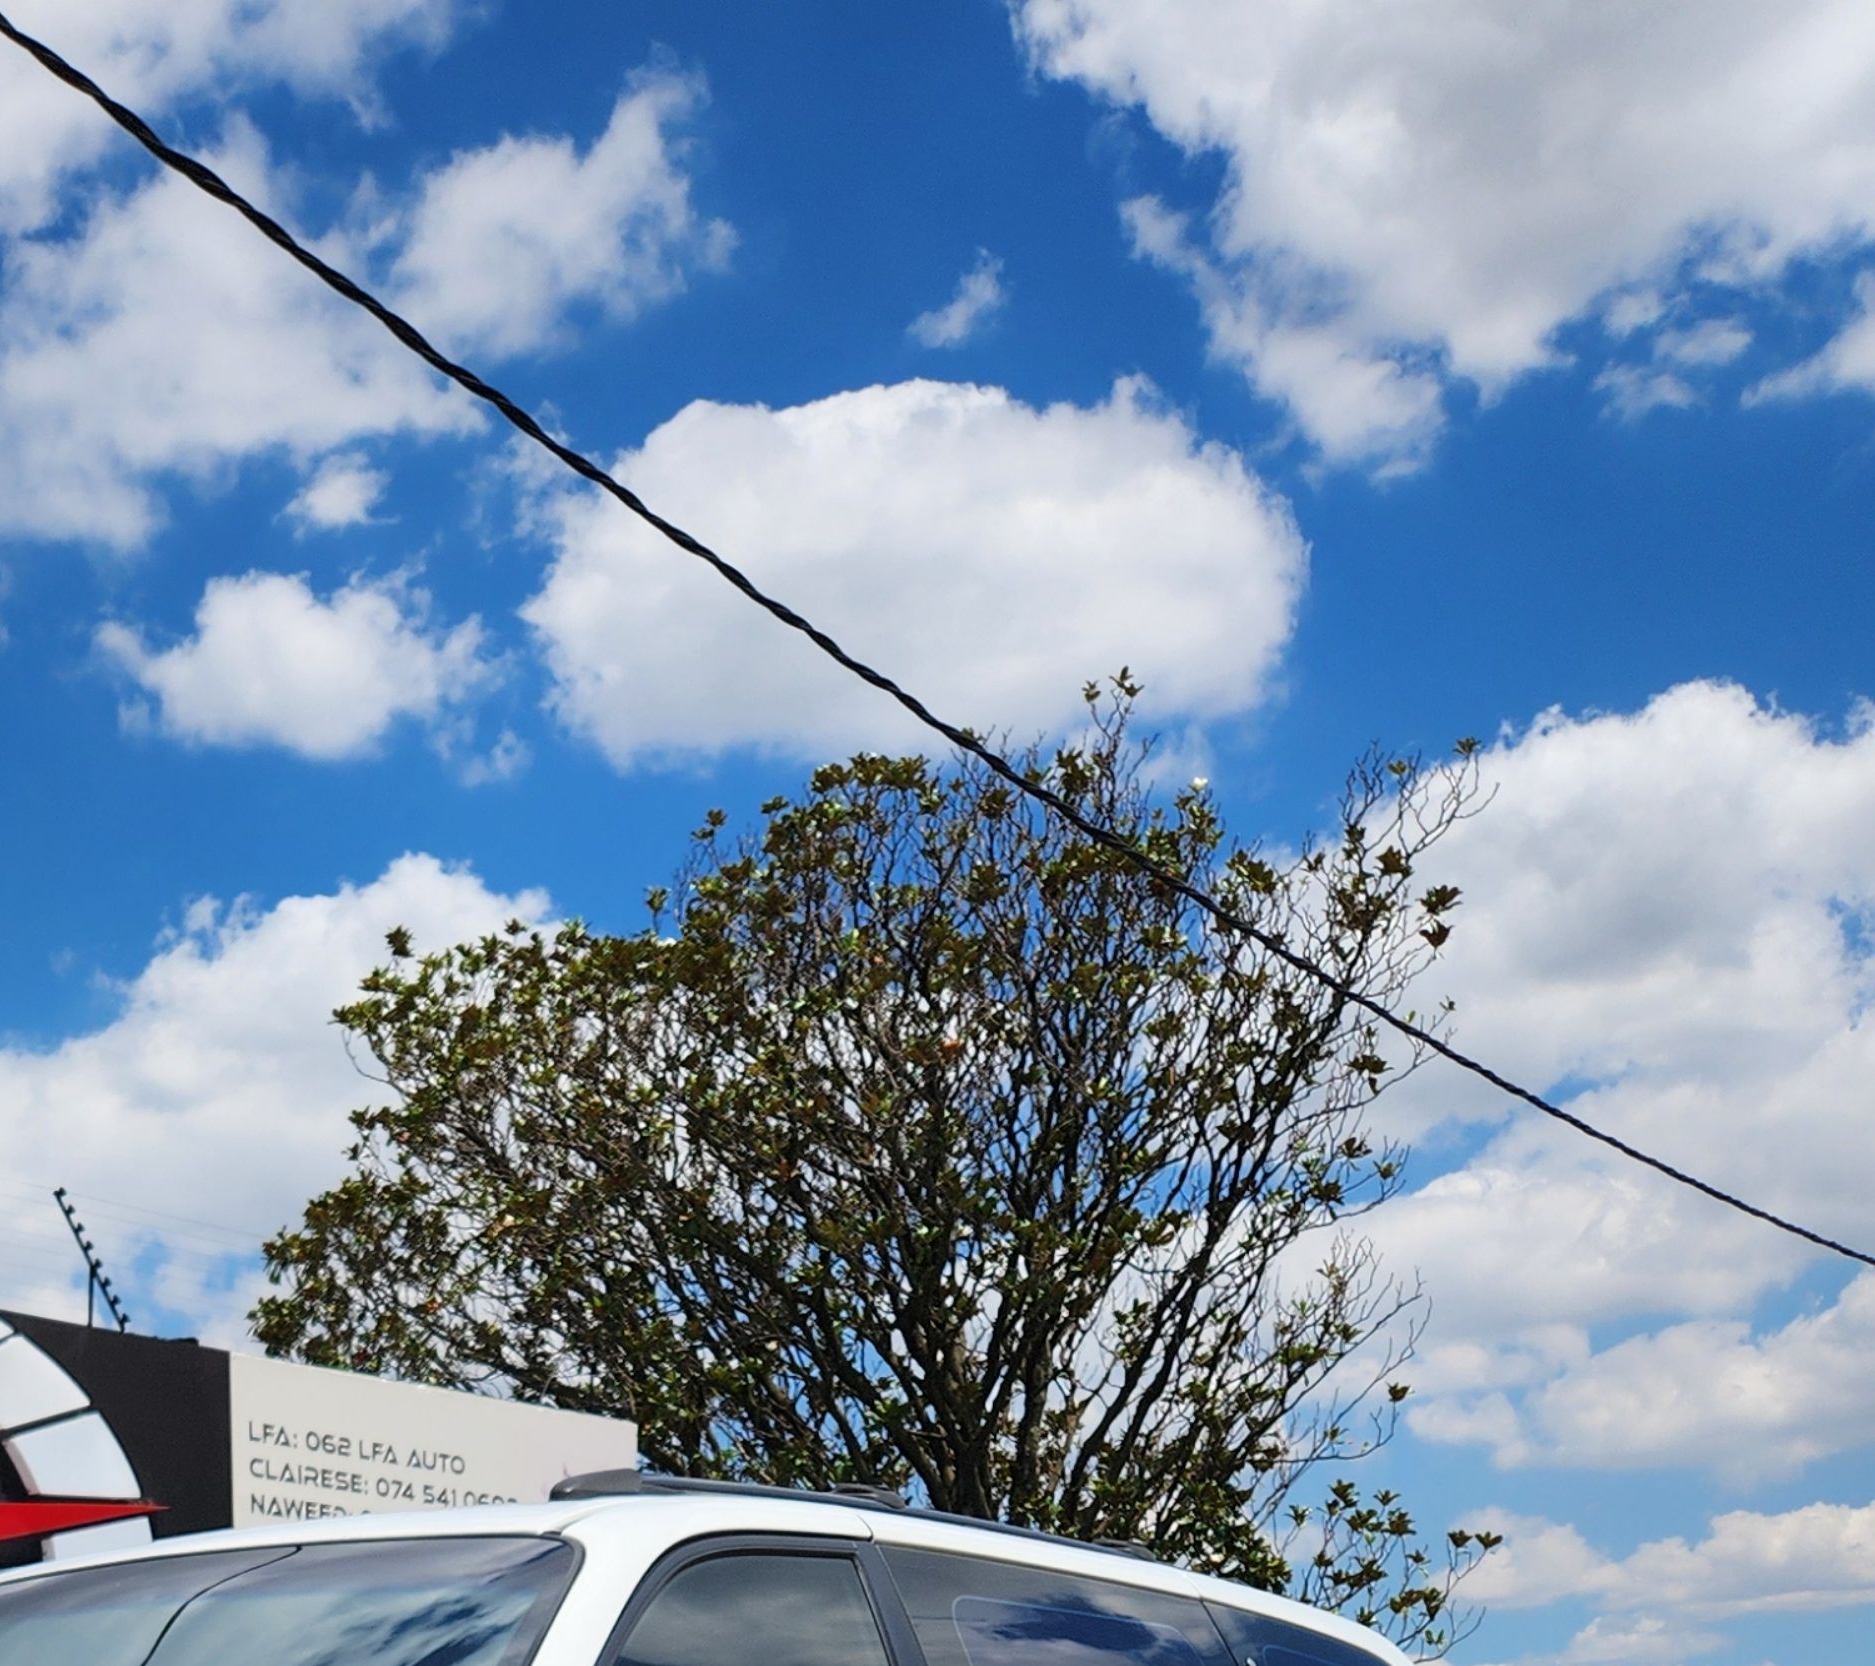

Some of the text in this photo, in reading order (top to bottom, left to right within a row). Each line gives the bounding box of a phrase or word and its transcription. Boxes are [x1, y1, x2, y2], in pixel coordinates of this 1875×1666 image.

[249, 1421, 466, 1475] LFA: 062 LFA AUTO
[249, 1458, 368, 1496] CLAIRESE:
[376, 1477, 415, 1501] 074
[423, 1484, 457, 1508] 541
